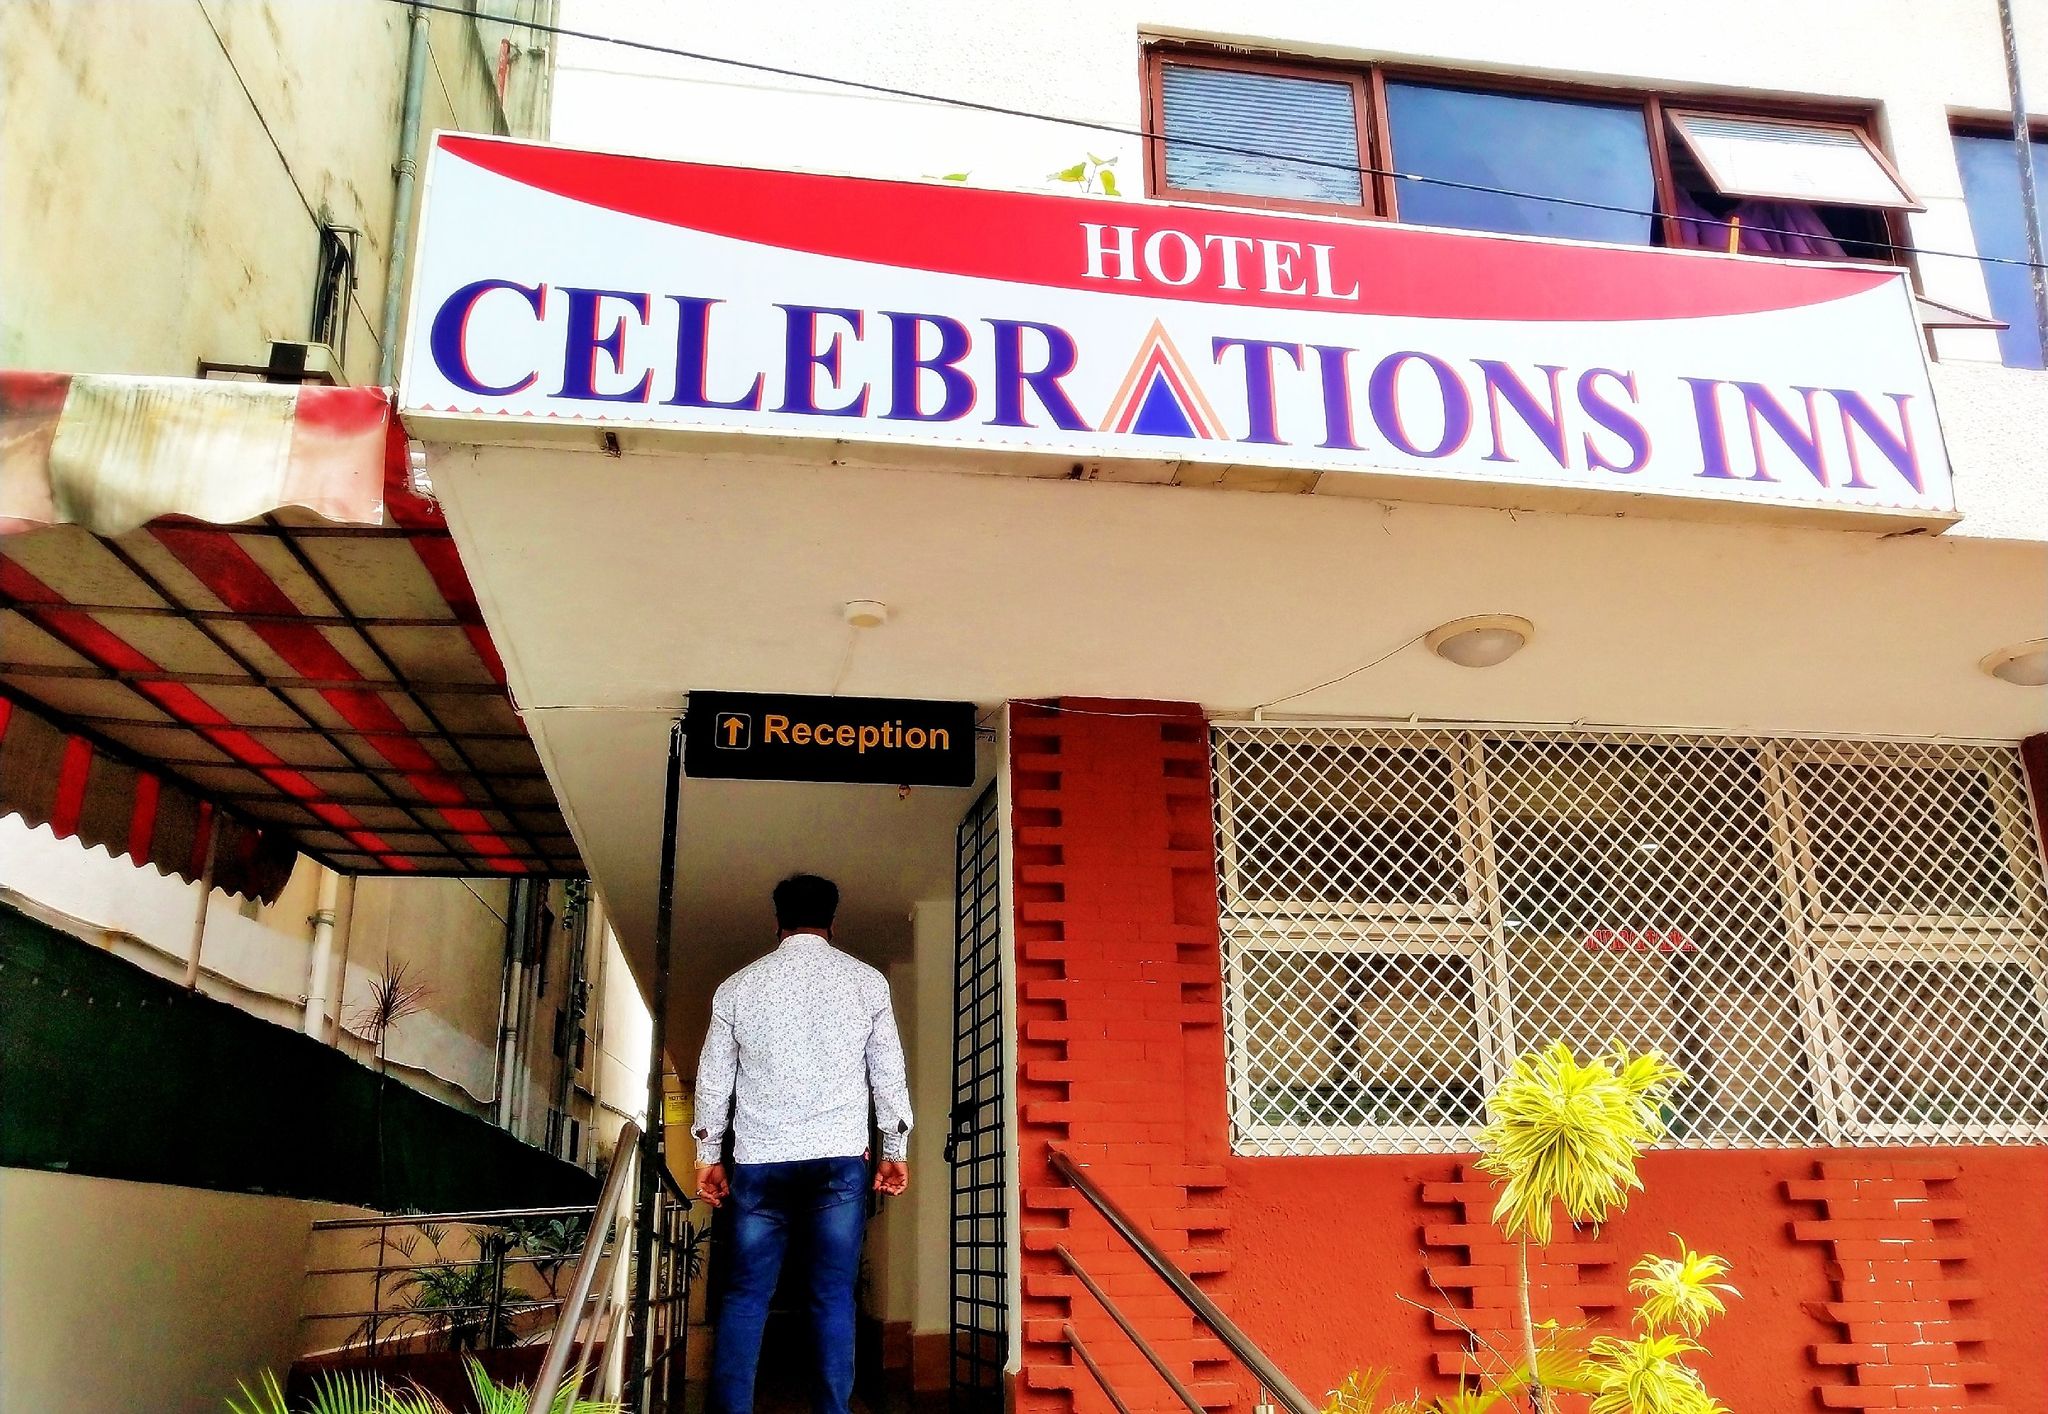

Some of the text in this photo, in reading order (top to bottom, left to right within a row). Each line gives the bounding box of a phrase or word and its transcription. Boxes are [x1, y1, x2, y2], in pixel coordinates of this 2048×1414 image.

[1079, 221, 1361, 302] HOTEL
[430, 278, 1924, 495] CELEBRATIONS INN
[763, 714, 950, 754] Reception
